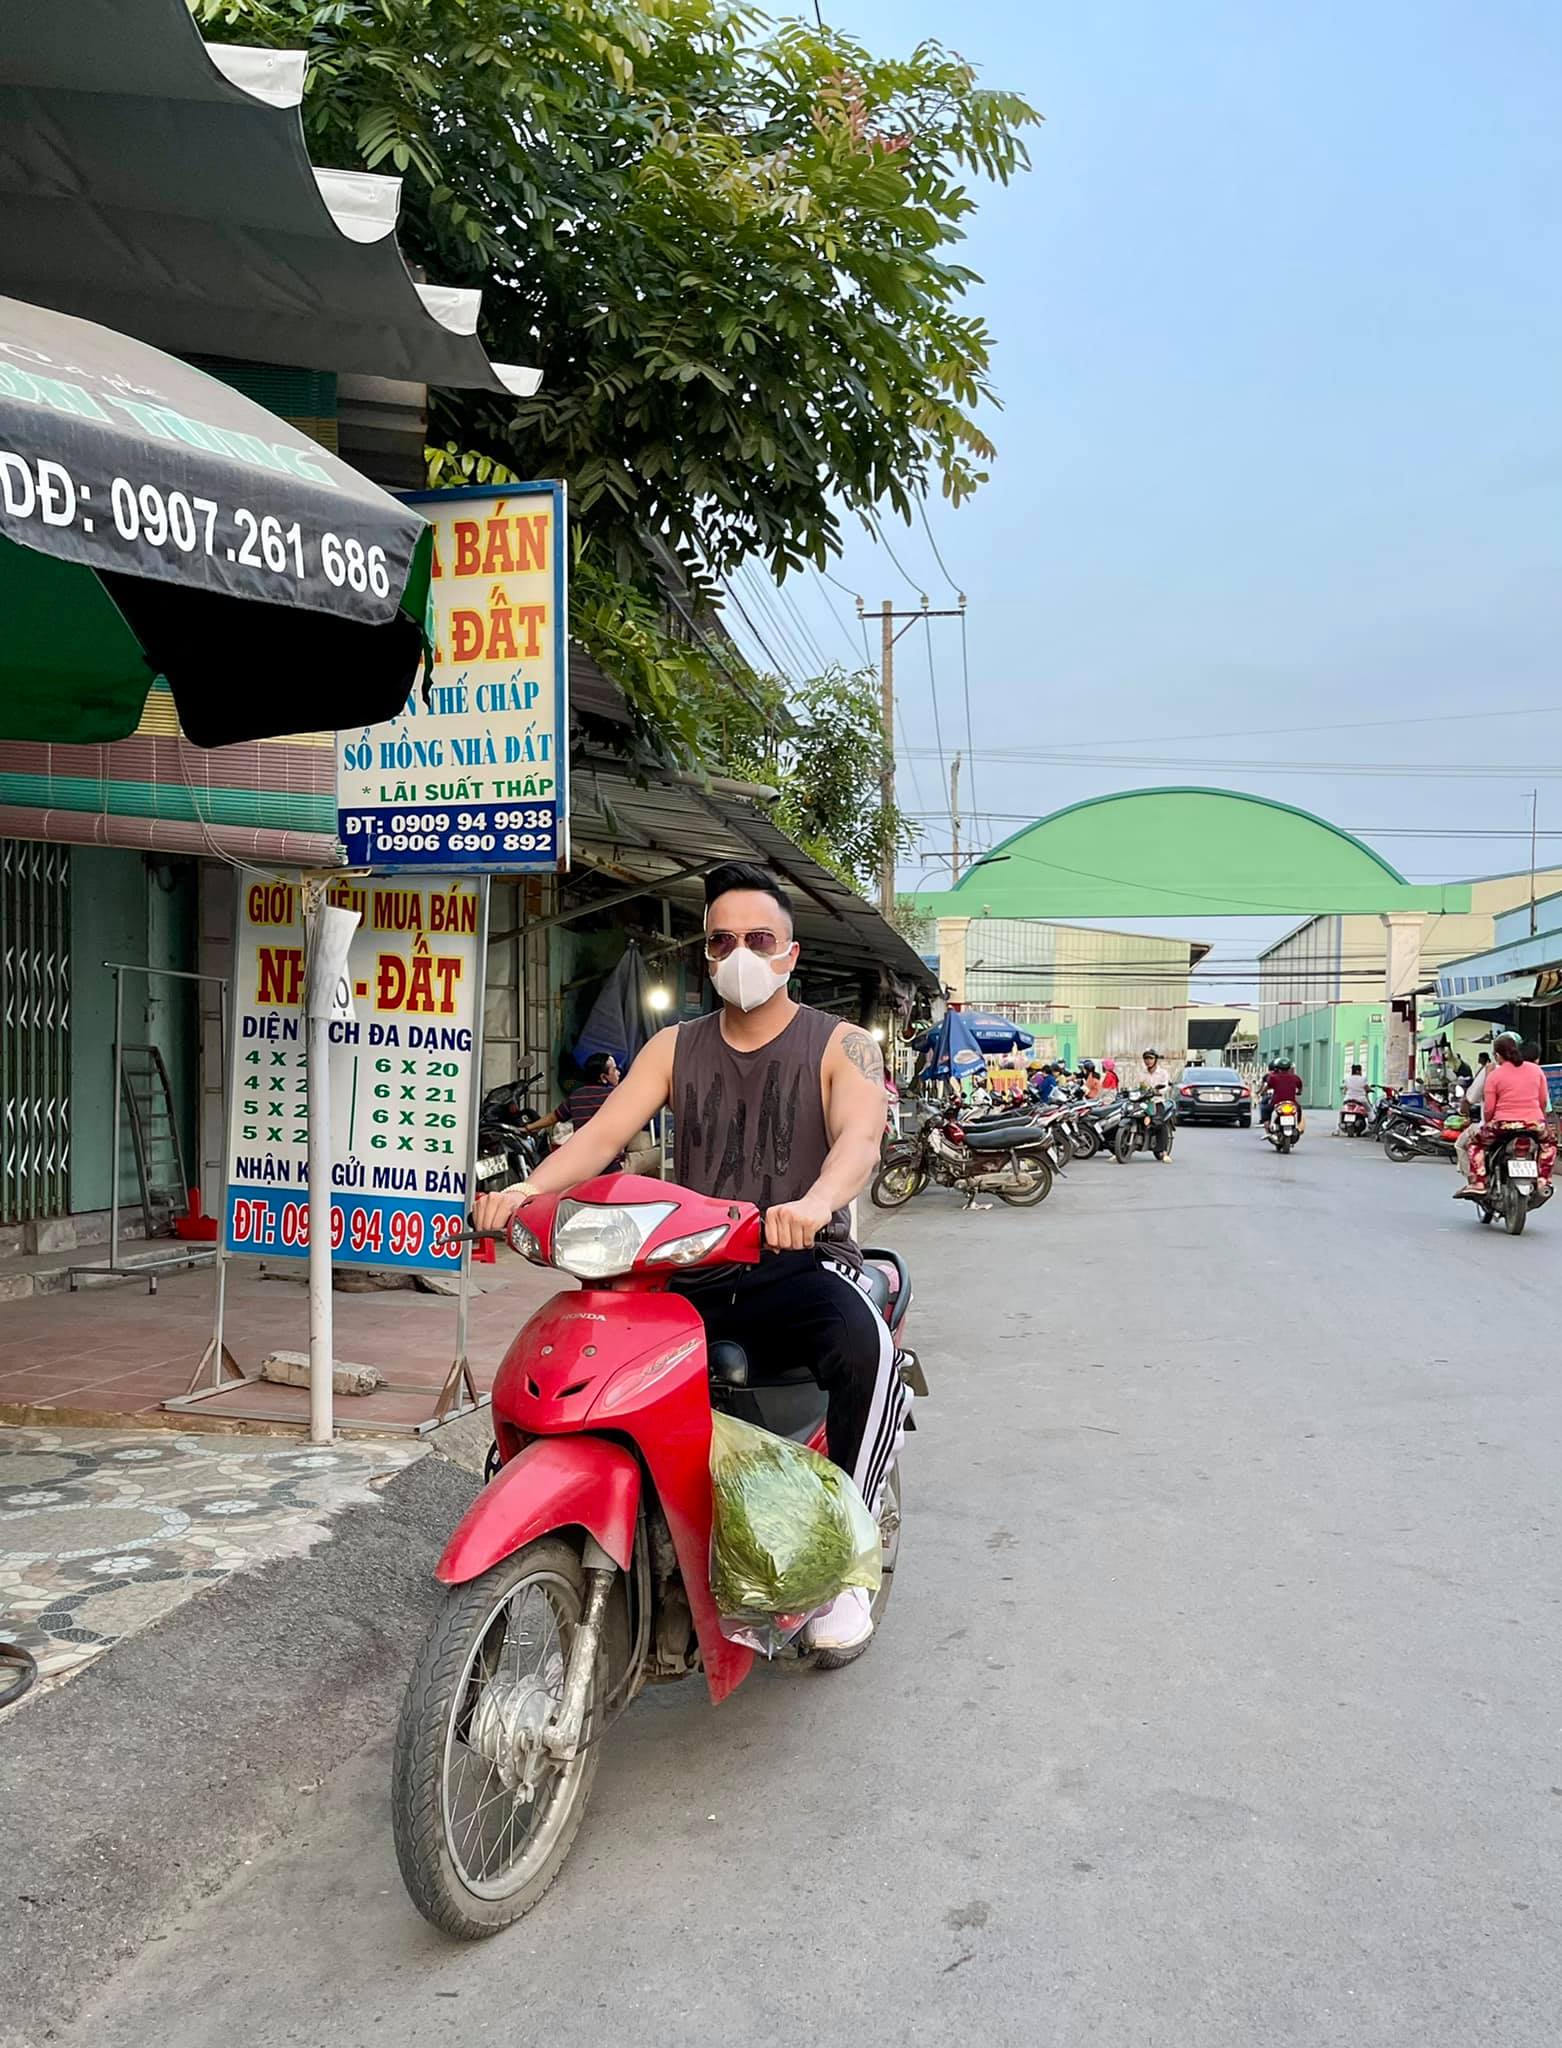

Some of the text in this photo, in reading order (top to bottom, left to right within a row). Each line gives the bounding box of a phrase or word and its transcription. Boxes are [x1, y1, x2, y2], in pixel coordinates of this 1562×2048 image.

[0, 450, 94, 533] DĐ:
[111, 477, 305, 579] 0907.261
[321, 531, 390, 599] 686
[454, 502, 548, 576] BÁN
[452, 586, 546, 662] ĐẤT
[427, 671, 469, 716] THẾ
[475, 668, 539, 713] CHẤP
[380, 727, 444, 769] HỒNG
[450, 729, 497, 767] NHÀ
[380, 771, 554, 802] LÃI SUẤT THẤP
[346, 809, 553, 835] ĐT: 0909 94 9938
[376, 833, 552, 851] 0906 690 892
[374, 891, 422, 930] MUA
[430, 884, 476, 932] BÁN
[258, 948, 305, 1005] NH
[378, 931, 461, 1013] ĐẤT
[242, 1011, 472, 1054] DIỆN CH ĐA DẠNG
[245, 1050, 261, 1065] 4
[297, 1053, 308, 1068] 2
[375, 1058, 391, 1073] 6
[426, 1061, 459, 1077] 20
[244, 1075, 260, 1090] 4
[295, 1078, 308, 1093] 2
[374, 1083, 390, 1098] 6
[425, 1087, 457, 1103] 21
[243, 1100, 259, 1115] 5
[294, 1103, 308, 1119] 2
[372, 1109, 389, 1124] 6
[424, 1112, 457, 1129] 26
[242, 1125, 258, 1140] 5
[292, 1129, 308, 1144] 2
[370, 1134, 387, 1149] 6
[424, 1138, 454, 1154] 31
[236, 1152, 290, 1185] NHẬN
[298, 1161, 309, 1183] K
[331, 1155, 365, 1187] GỬI
[372, 1166, 417, 1191] MUA
[425, 1165, 466, 1194] BÁN
[233, 1199, 464, 1259] ĐT: 099 94 99 38
